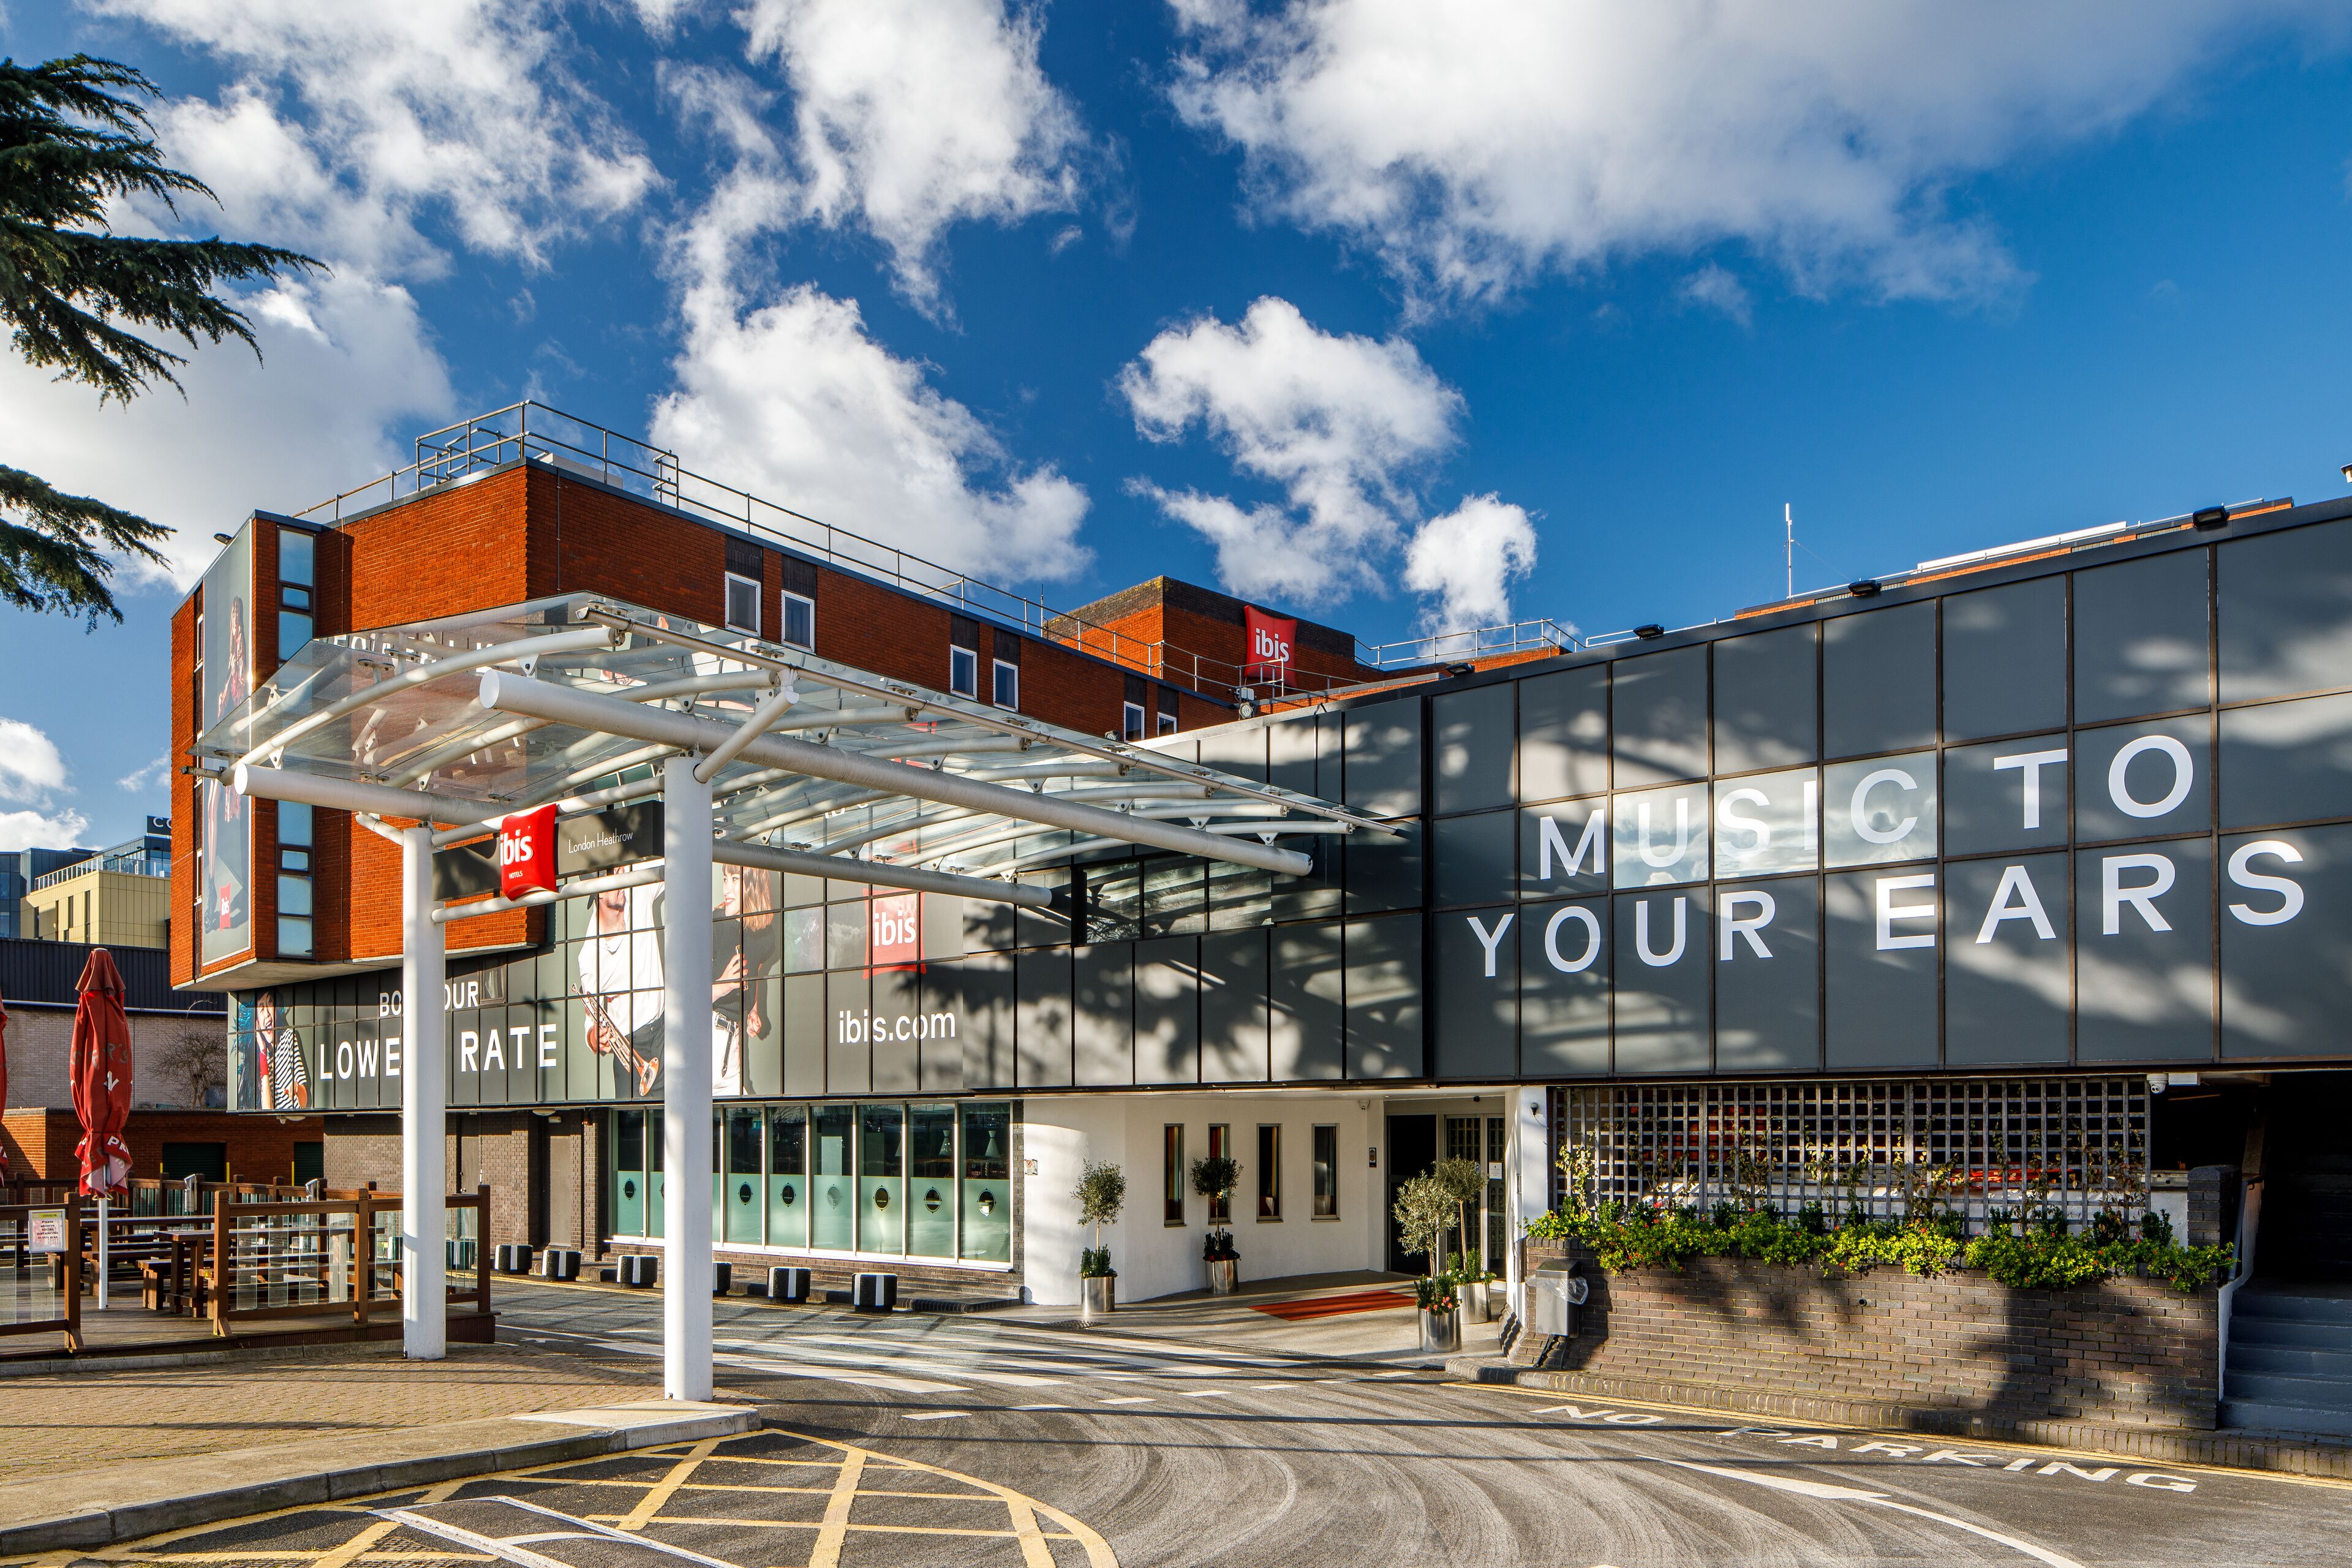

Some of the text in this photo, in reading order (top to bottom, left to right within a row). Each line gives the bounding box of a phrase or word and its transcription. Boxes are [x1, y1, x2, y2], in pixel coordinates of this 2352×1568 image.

[1255, 628, 1289, 662] ibis
[1540, 735, 2194, 880] MUSIC TO
[500, 829, 533, 867] ibis
[568, 827, 633, 854] London Heathrow
[508, 870, 523, 880] HOTELS
[1467, 840, 2305, 978] YOUR EARS
[874, 910, 916, 946] ibis
[839, 1009, 956, 1044] ibis.com
[461, 1023, 557, 1072] RATE
[1528, 1404, 2198, 1493] NO PARKING
